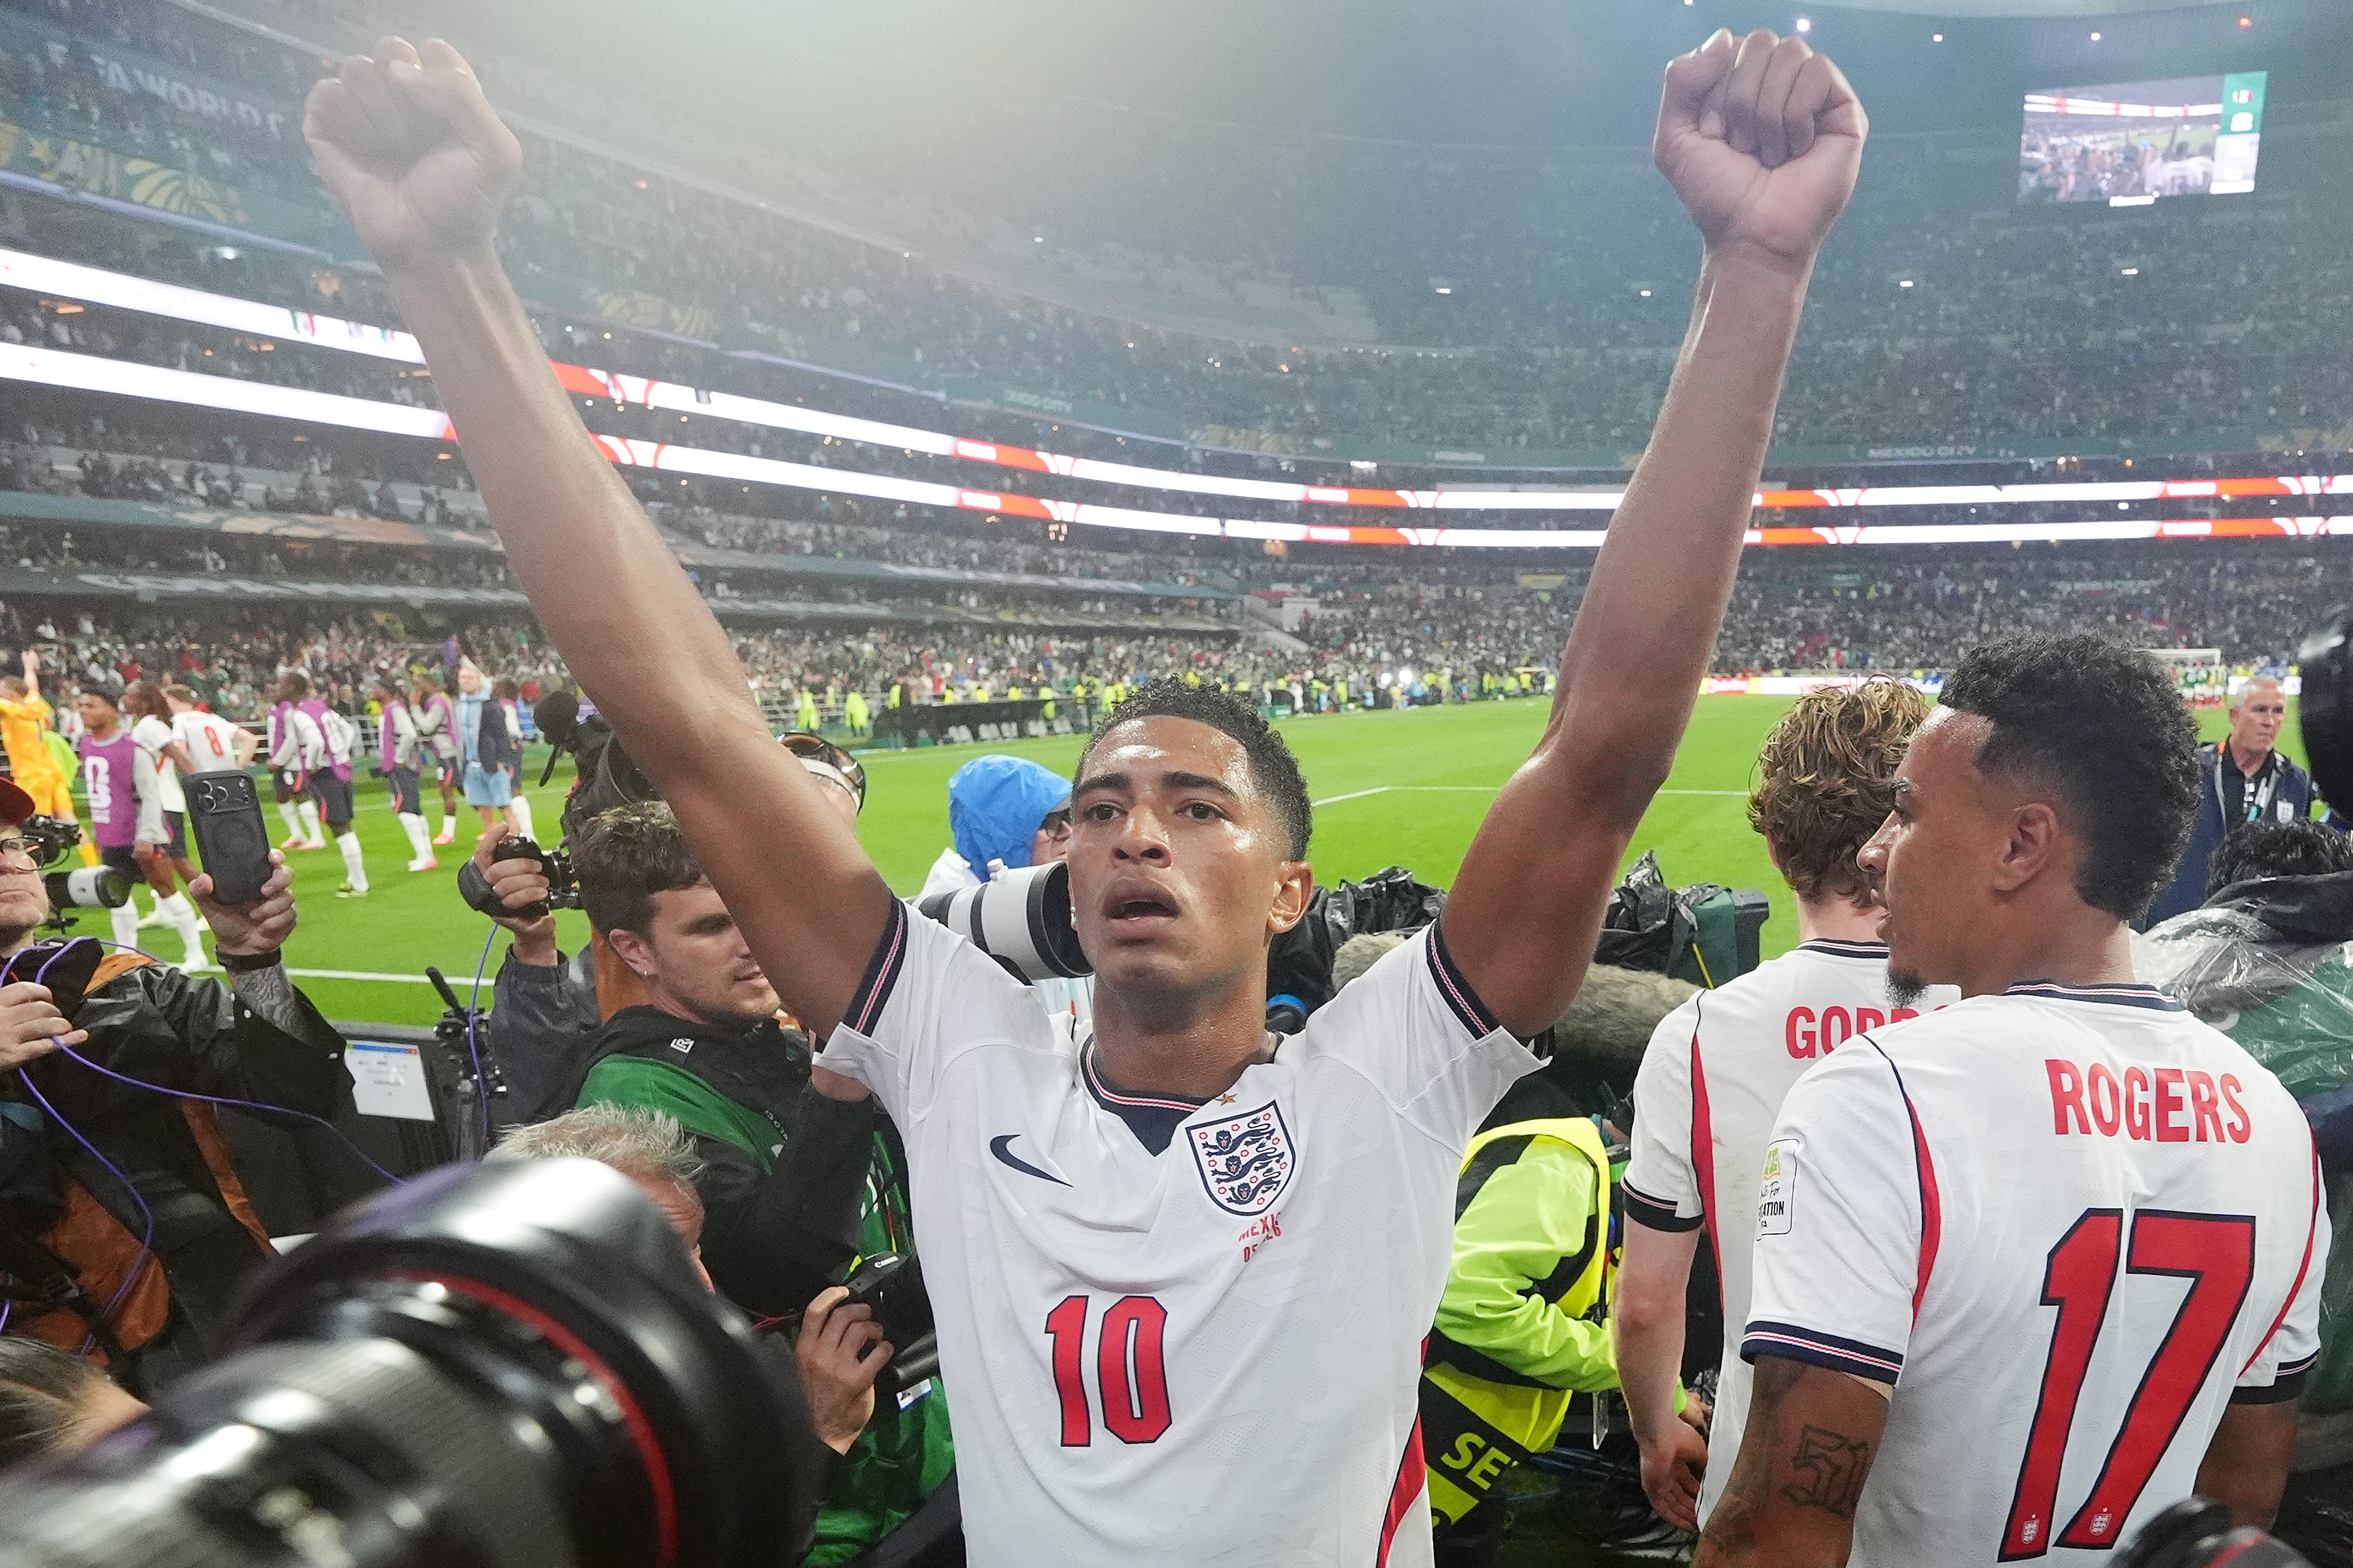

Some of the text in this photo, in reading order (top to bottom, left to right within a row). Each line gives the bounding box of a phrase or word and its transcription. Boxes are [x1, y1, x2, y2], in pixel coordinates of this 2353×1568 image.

[204, 725, 224, 756] 8
[2044, 1058, 2252, 1144] ROGERS
[1758, 1201, 1784, 1221] ATION
[1045, 1295, 1173, 1448] 10
[1998, 1208, 2256, 1563] 17
[1440, 1433, 1519, 1491] SE
